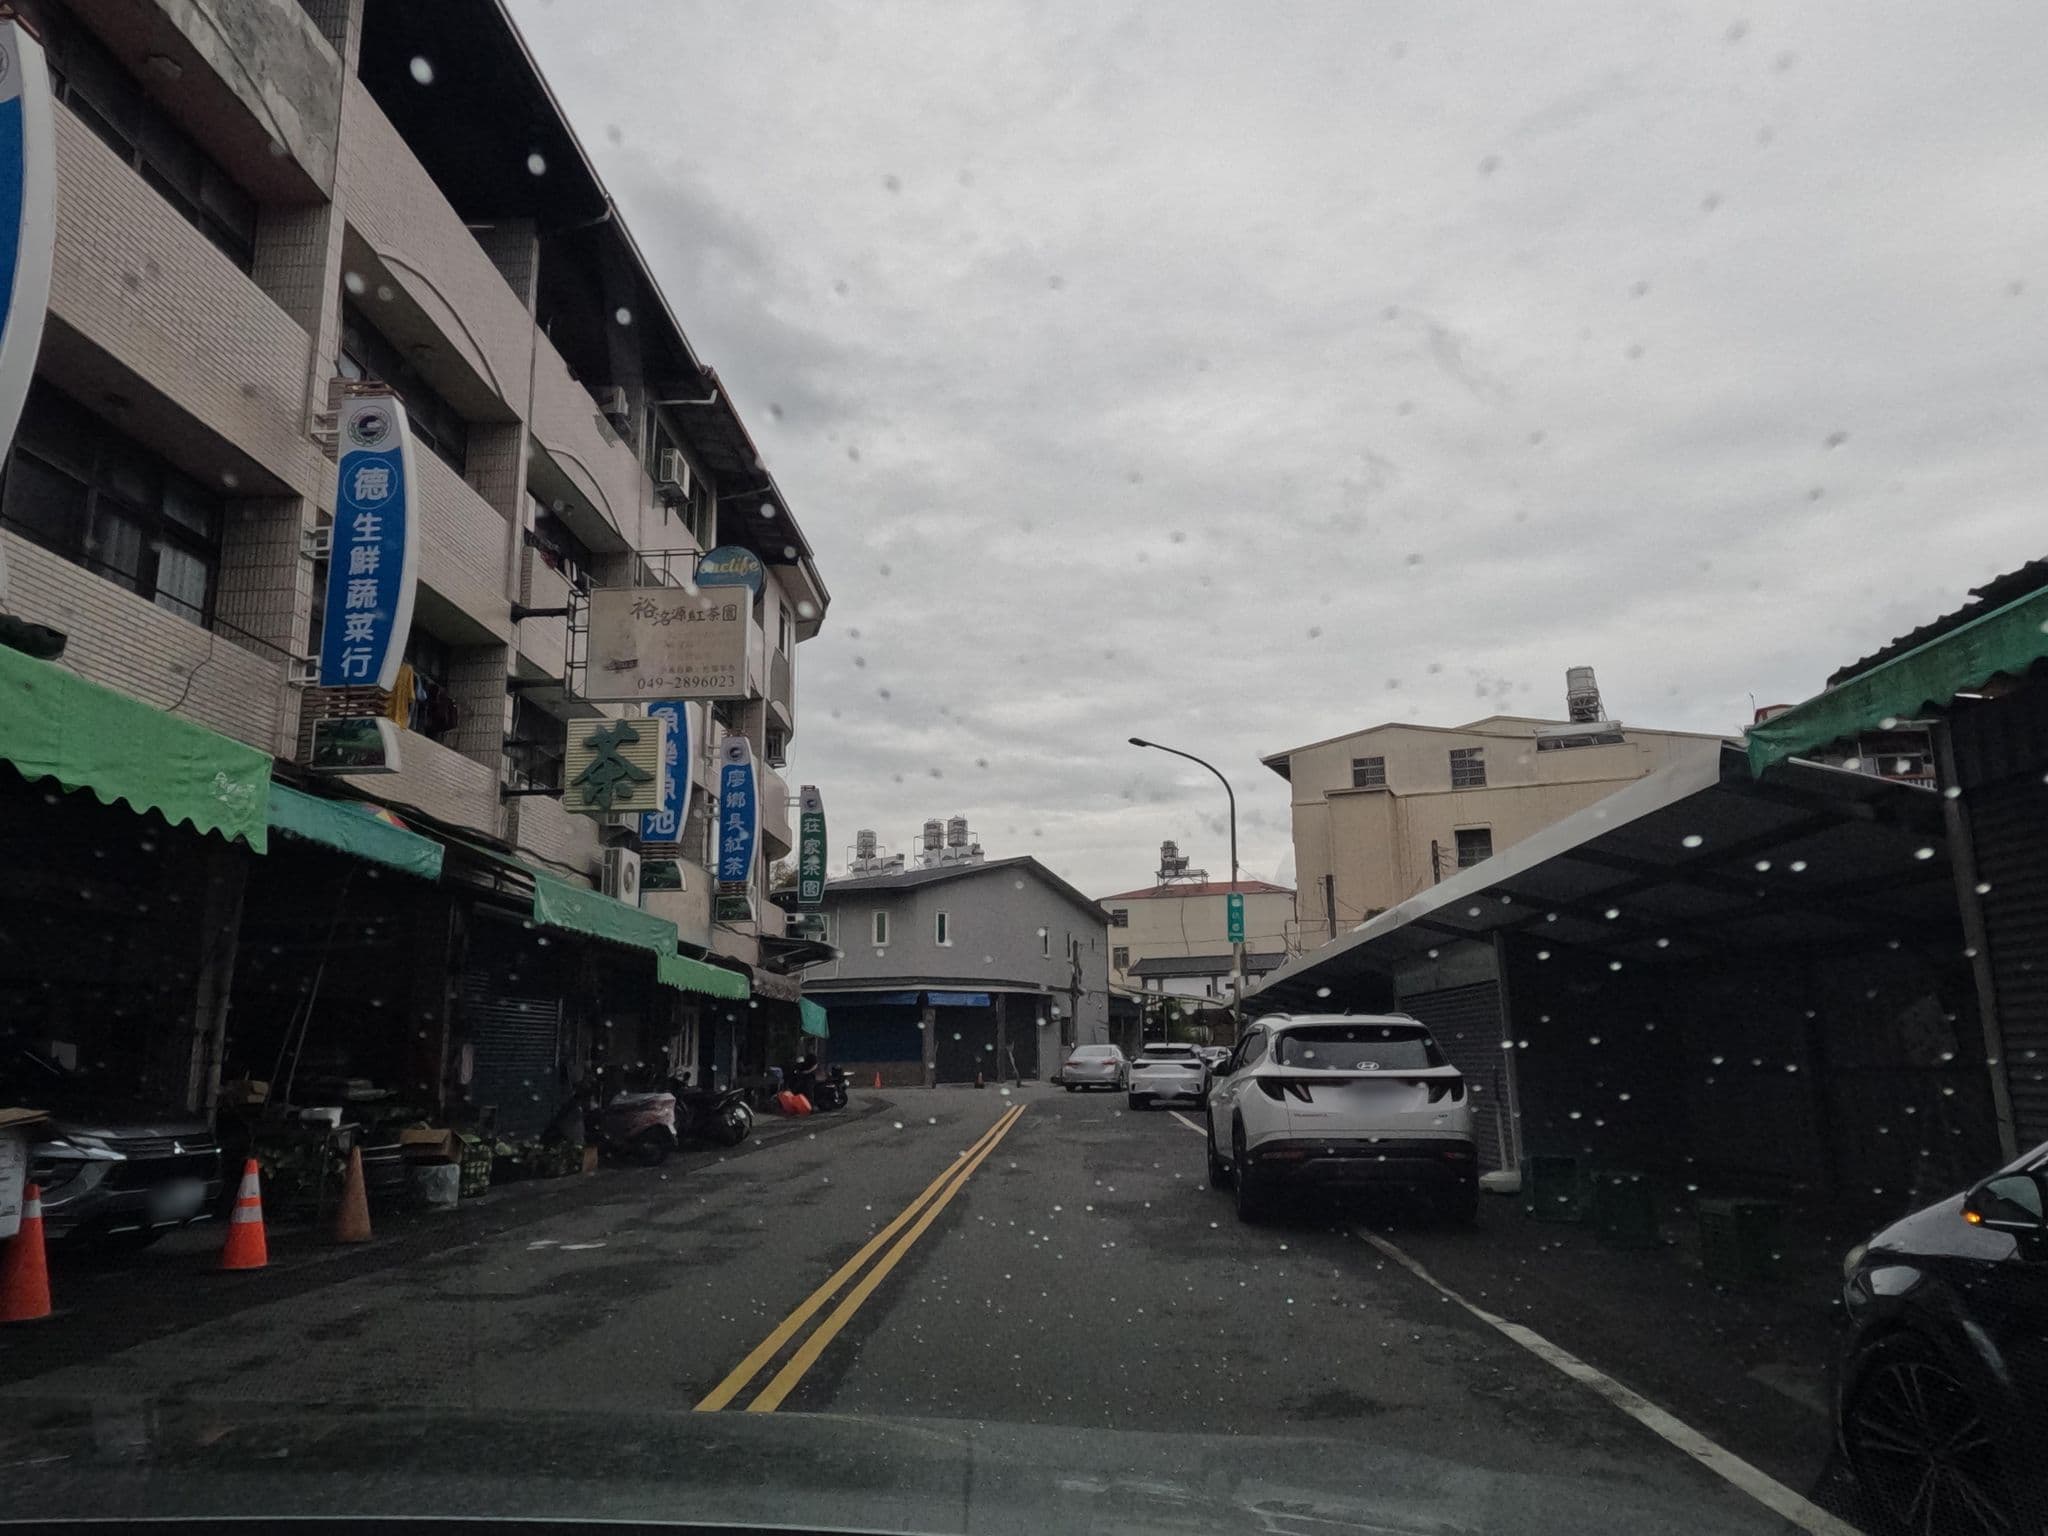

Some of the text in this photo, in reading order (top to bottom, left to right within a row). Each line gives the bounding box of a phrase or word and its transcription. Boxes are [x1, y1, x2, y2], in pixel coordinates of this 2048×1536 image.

[340, 466, 390, 679] 德生鮮蔬菜行
[637, 675, 736, 690] 049-2896023
[571, 719, 654, 811] 茶
